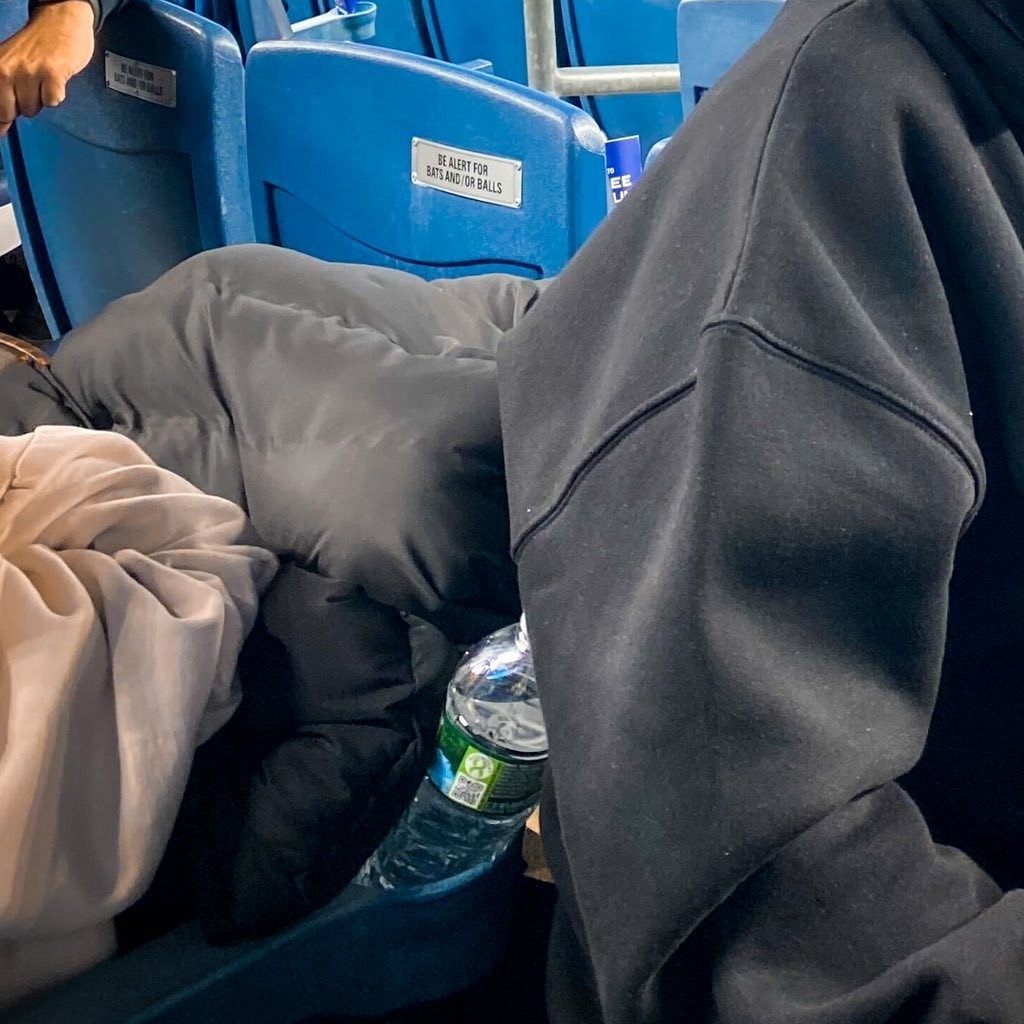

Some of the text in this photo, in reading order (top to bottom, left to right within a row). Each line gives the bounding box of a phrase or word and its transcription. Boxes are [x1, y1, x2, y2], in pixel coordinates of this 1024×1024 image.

[438, 154, 489, 177] BE ALERT FOR
[426, 165, 503, 195] BATS AND/OR BALLS
